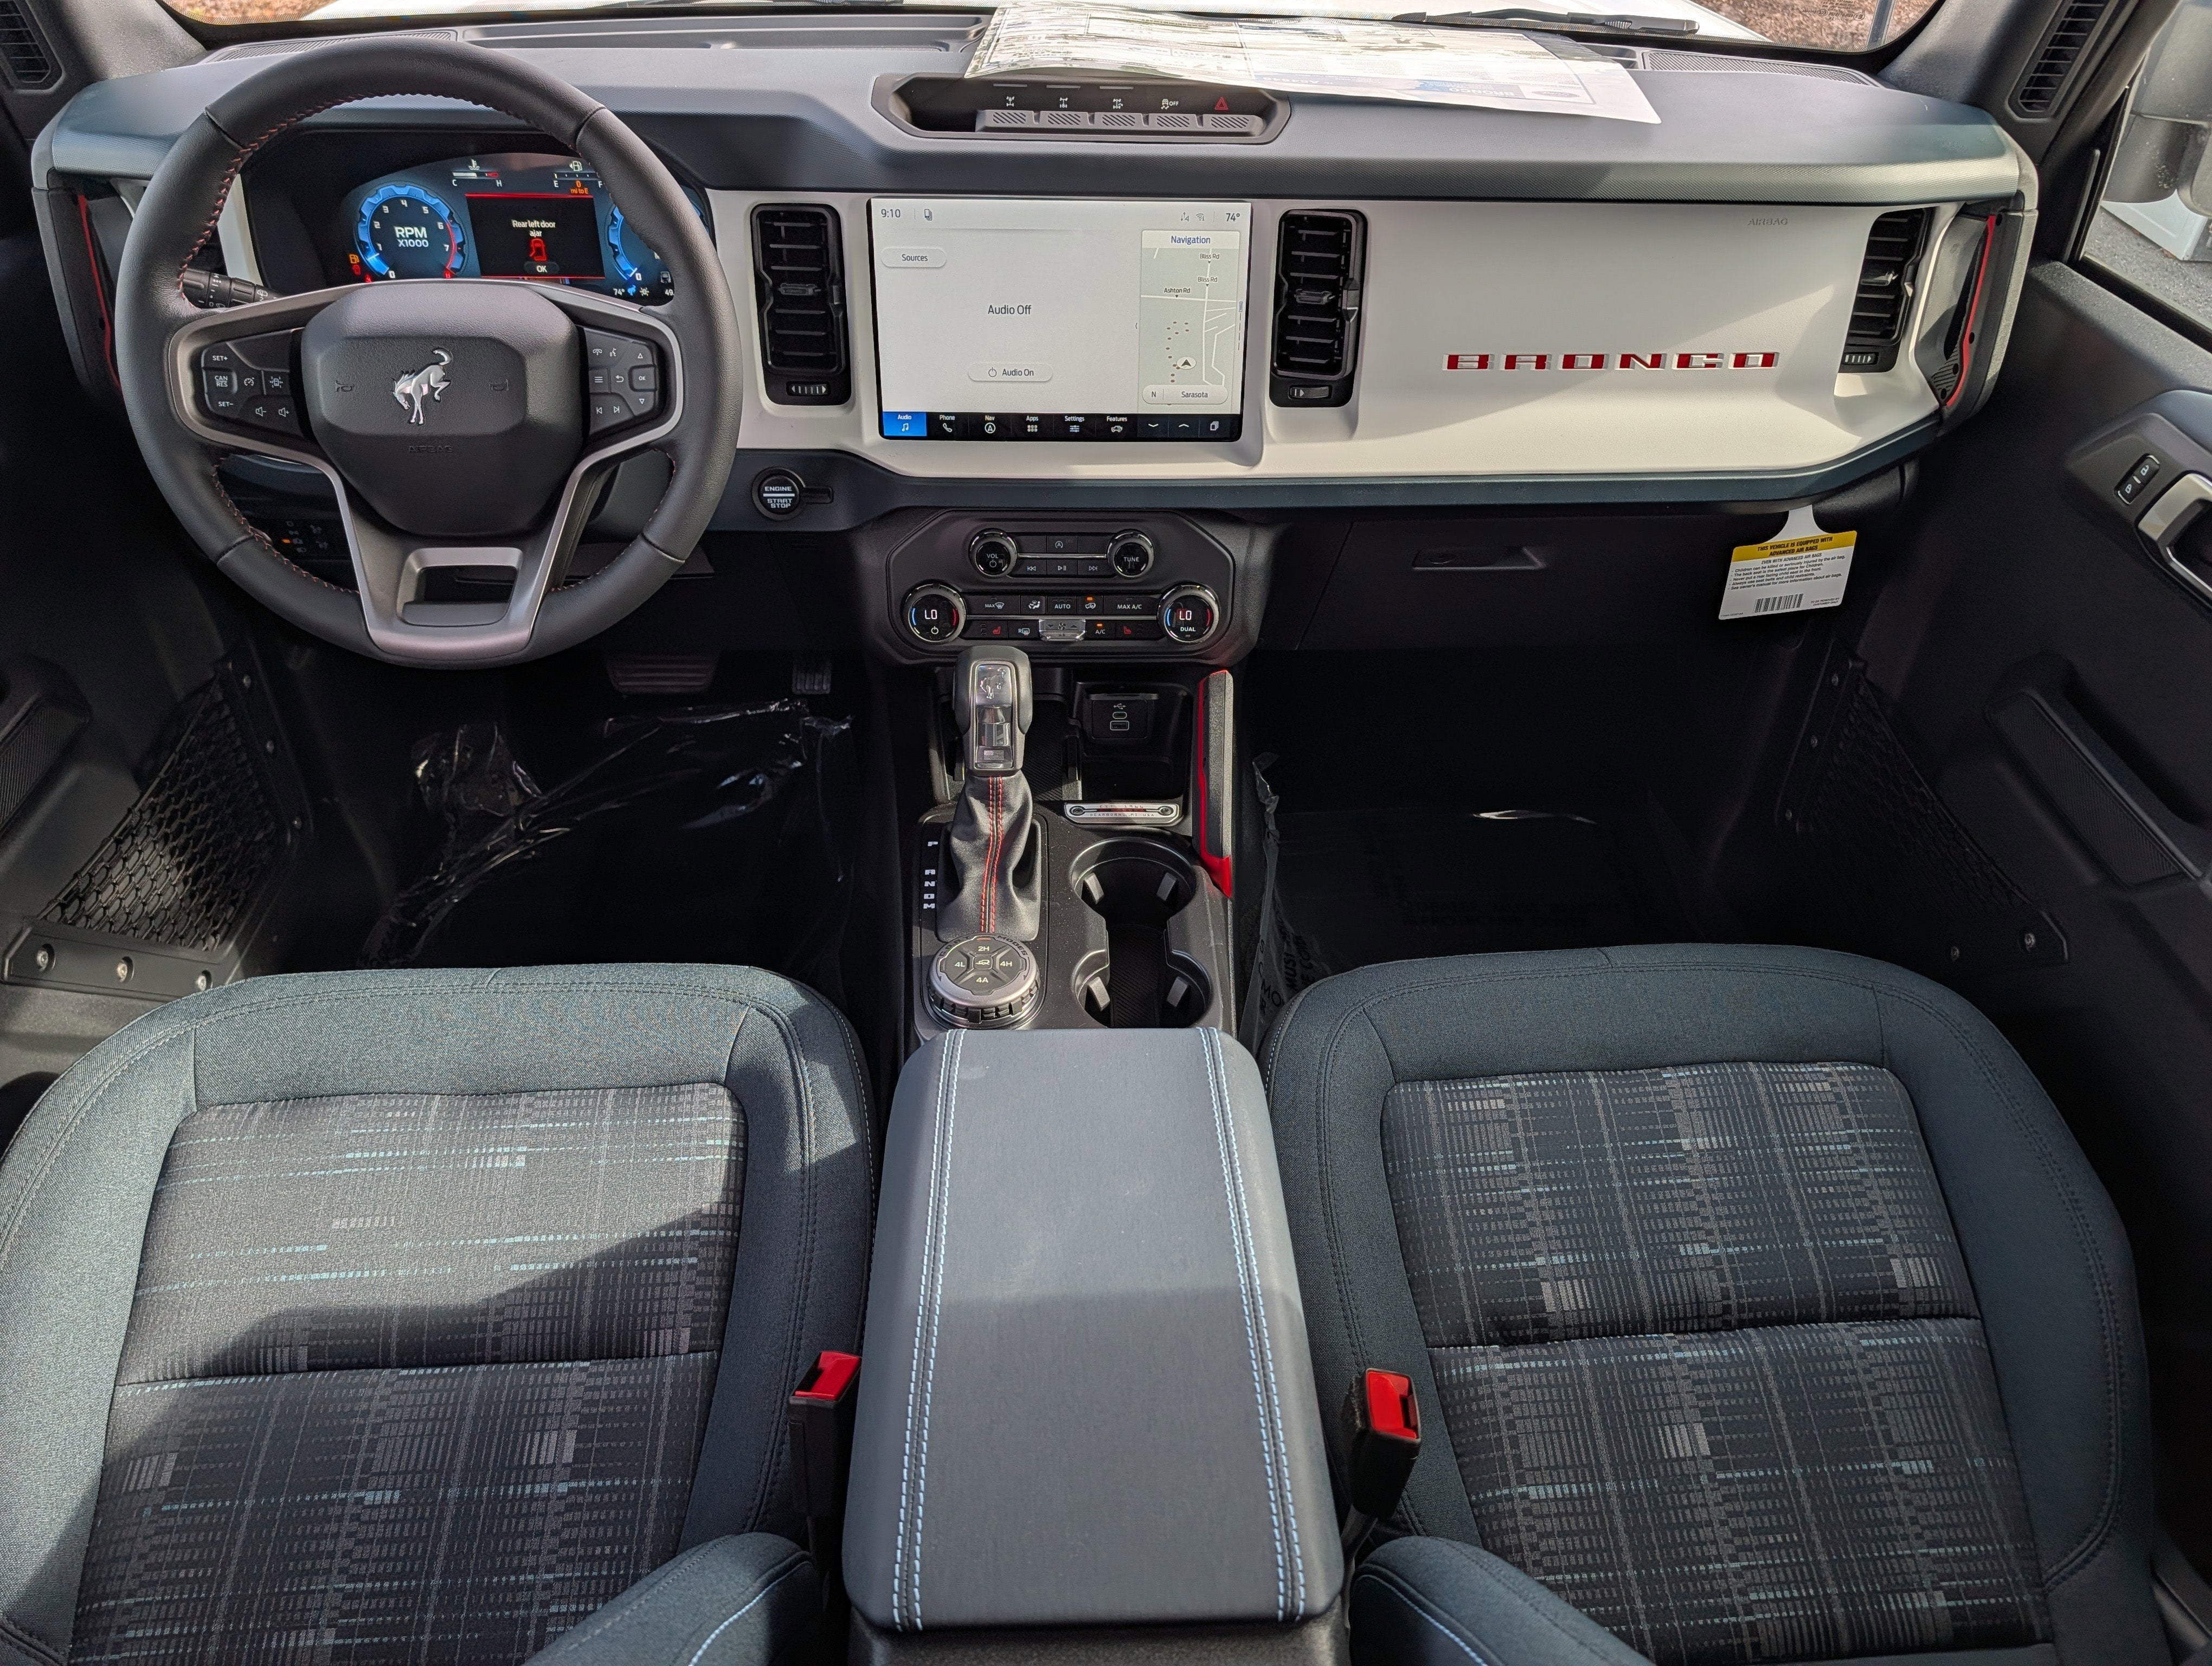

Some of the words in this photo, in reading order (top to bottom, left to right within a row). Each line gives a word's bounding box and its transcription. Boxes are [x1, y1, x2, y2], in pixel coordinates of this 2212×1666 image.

[401, 199, 408, 207] 4
[881, 209, 901, 219] 9:10
[1226, 213, 1240, 222] 74°
[373, 221, 381, 229] 2
[511, 219, 527, 228] Rear
[528, 219, 539, 228] left
[541, 219, 556, 228] door
[394, 226, 428, 238] RPM
[530, 229, 542, 238] ajar
[397, 239, 429, 247] X1000
[1171, 235, 1211, 246] Navigation
[902, 253, 928, 262] Sources
[635, 273, 642, 281] 0
[988, 305, 1013, 315] Audio
[1015, 305, 1032, 315] Off
[1443, 352, 1780, 370] BRONCO
[1002, 368, 1021, 377] Audio
[1022, 368, 1034, 377] On
[1181, 390, 1208, 399] Sarasota
[998, 935, 1028, 956] MODES
